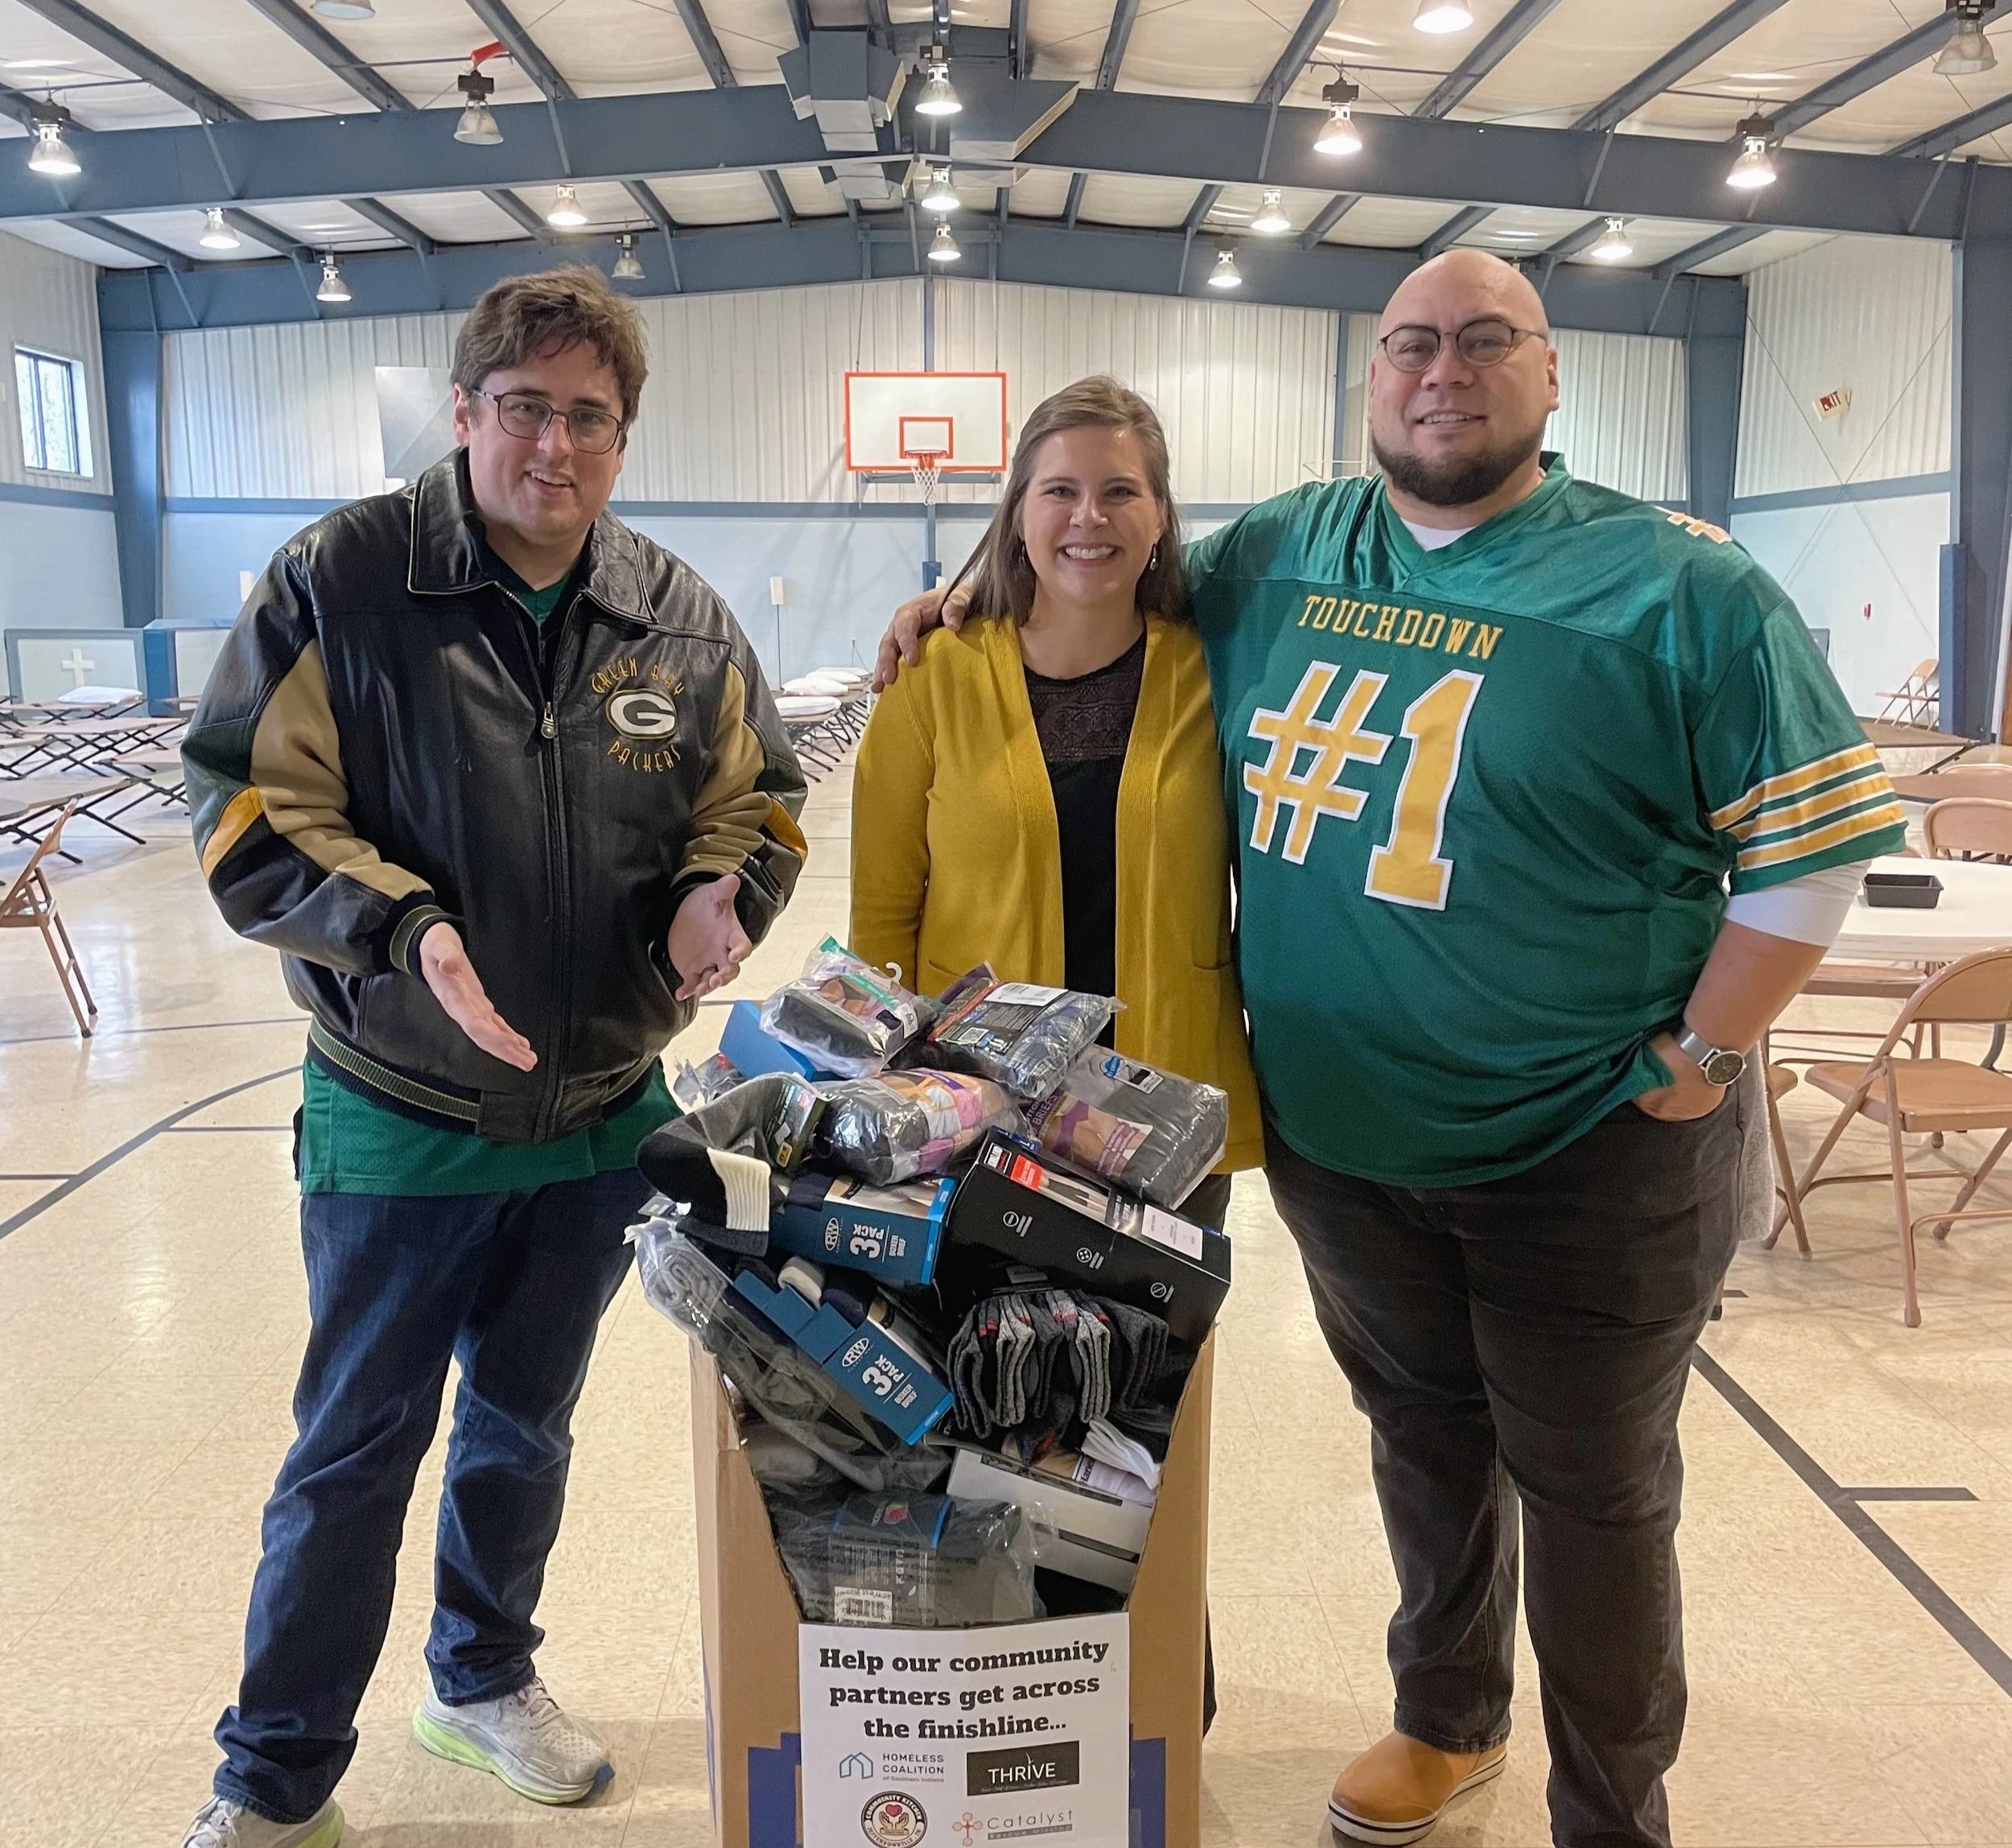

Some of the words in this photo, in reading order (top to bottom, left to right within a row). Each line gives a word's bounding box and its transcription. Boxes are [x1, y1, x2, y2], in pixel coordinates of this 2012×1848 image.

[1820, 391, 1841, 411] EXIT
[1297, 595, 1503, 660] TOUCHDOWN
[592, 658, 637, 694] GREEN
[650, 664, 686, 695] BAY
[610, 692, 676, 735] G
[607, 740, 682, 773] PACKERS
[1243, 659, 1485, 910] #1
[826, 1220, 839, 1248] RW
[853, 1223, 885, 1240] PACK
[850, 1236, 880, 1259] 3
[844, 1339, 868, 1365] RW
[862, 1366, 893, 1396] 3
[874, 1354, 905, 1383] PACK
[819, 1648, 883, 1675] Help
[893, 1656, 941, 1673] our
[950, 1640, 1109, 1672] community
[830, 1685, 950, 1706] partners
[959, 1685, 1004, 1710] get
[1012, 1677, 1100, 1701] across
[864, 1718, 909, 1739] the
[918, 1715, 1066, 1739] finishline...
[883, 1753, 944, 1763] HOMELESS
[883, 1764, 944, 1774] COALITION
[987, 1759, 1056, 1784] THRIVE
[987, 1809, 1073, 1829] Catalyst
